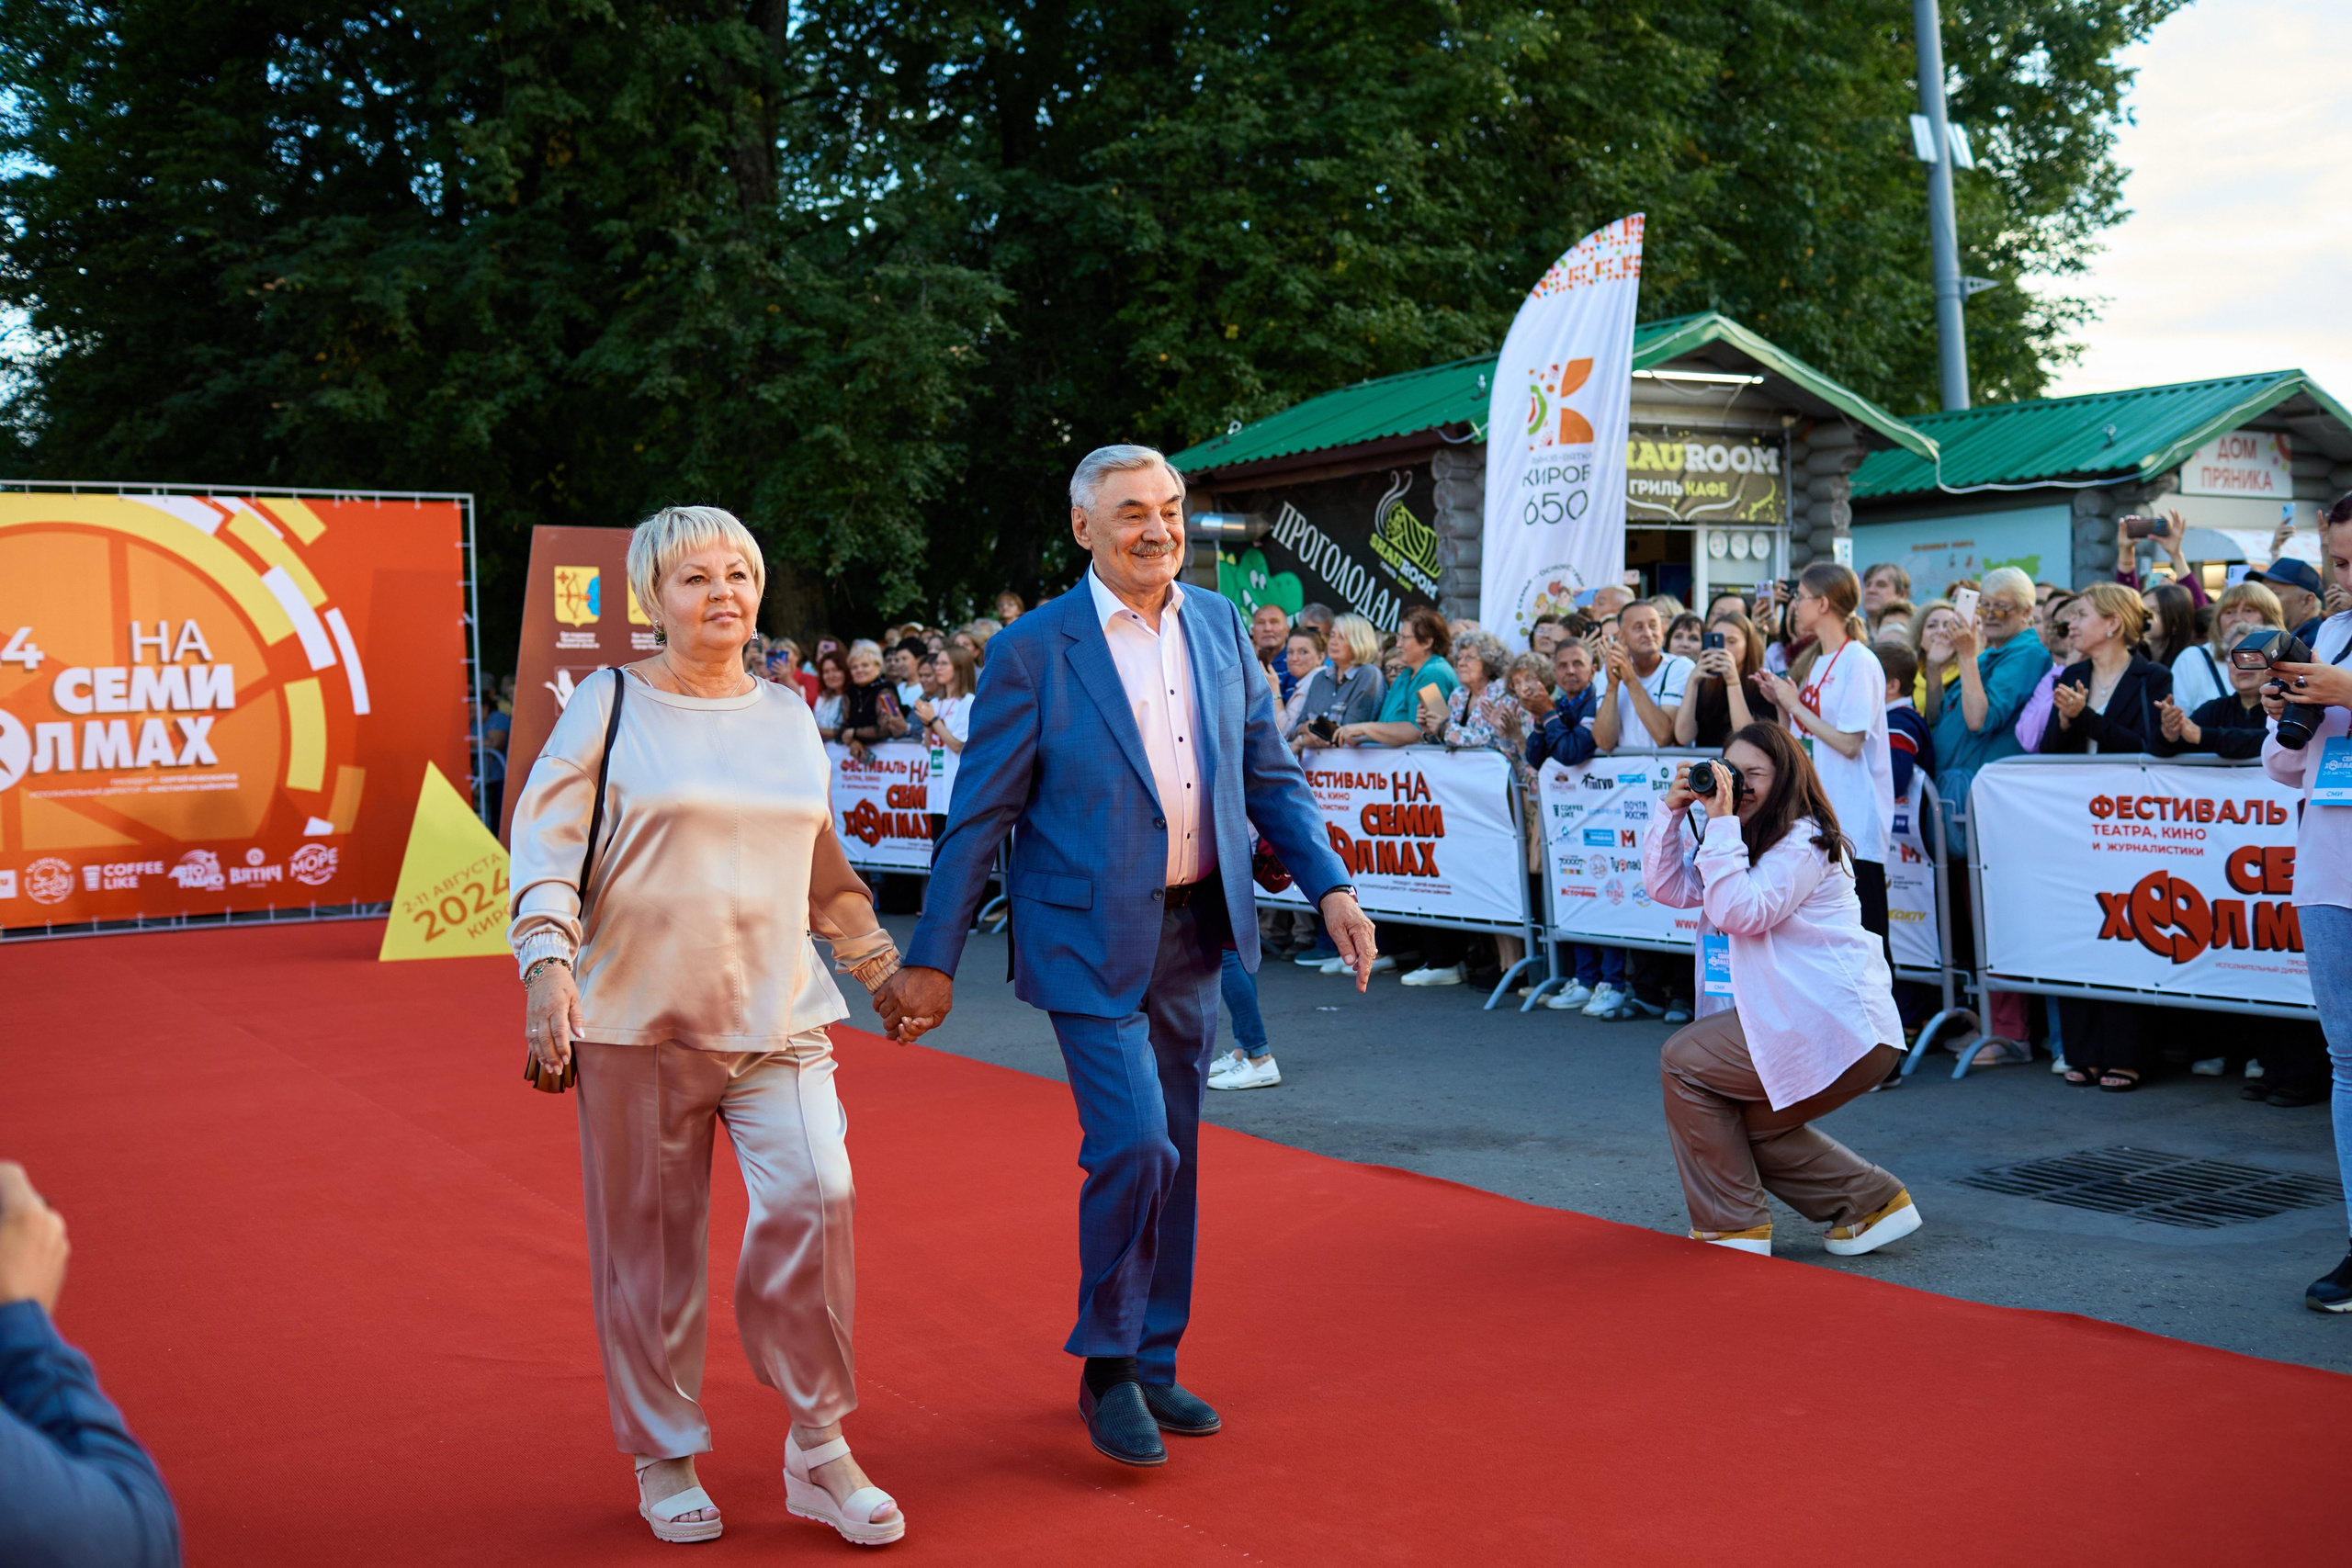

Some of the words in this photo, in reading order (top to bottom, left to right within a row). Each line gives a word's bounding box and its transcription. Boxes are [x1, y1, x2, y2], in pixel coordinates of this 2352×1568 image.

[1627, 441, 1781, 475] AUROOM
[2217, 437, 2257, 461] ДОМ
[1629, 479, 1683, 497] ГРИЛЬ
[1685, 480, 1728, 497] КАФЕ
[2201, 467, 2274, 491] ПРЯНИКА
[1523, 490, 1589, 525] 650
[1272, 501, 1404, 635] ПРОГОЛОДАЛ
[131, 618, 213, 663] НА
[52, 663, 236, 715] СЕМИ
[886, 784, 928, 809] СЕМ
[1306, 770, 1388, 791] ЕСТИВАЛЬ
[1392, 771, 1432, 803] НА
[1328, 791, 1351, 801] КИНО
[1361, 802, 1445, 838] СЕМИ
[2088, 795, 2289, 826] ФЕСТИВАЛЬ
[2091, 824, 2158, 840] ТЕАТРА,
[2161, 827, 2207, 840] КИНО
[289, 847, 339, 877] МОРЕ
[1326, 821, 1440, 878] ЛМАХ
[2092, 842, 2101, 851] И
[2107, 842, 2204, 856] ЖУРНАЛИСТИКИ
[103, 861, 164, 877] COFFEE
[103, 875, 139, 890] LIKE
[433, 852, 503, 898] АВГУСТА
[2224, 845, 2296, 895] СЕ
[2095, 869, 2305, 964] ХОЛМ
[2280, 966, 2310, 975] ДИРЕКТ
